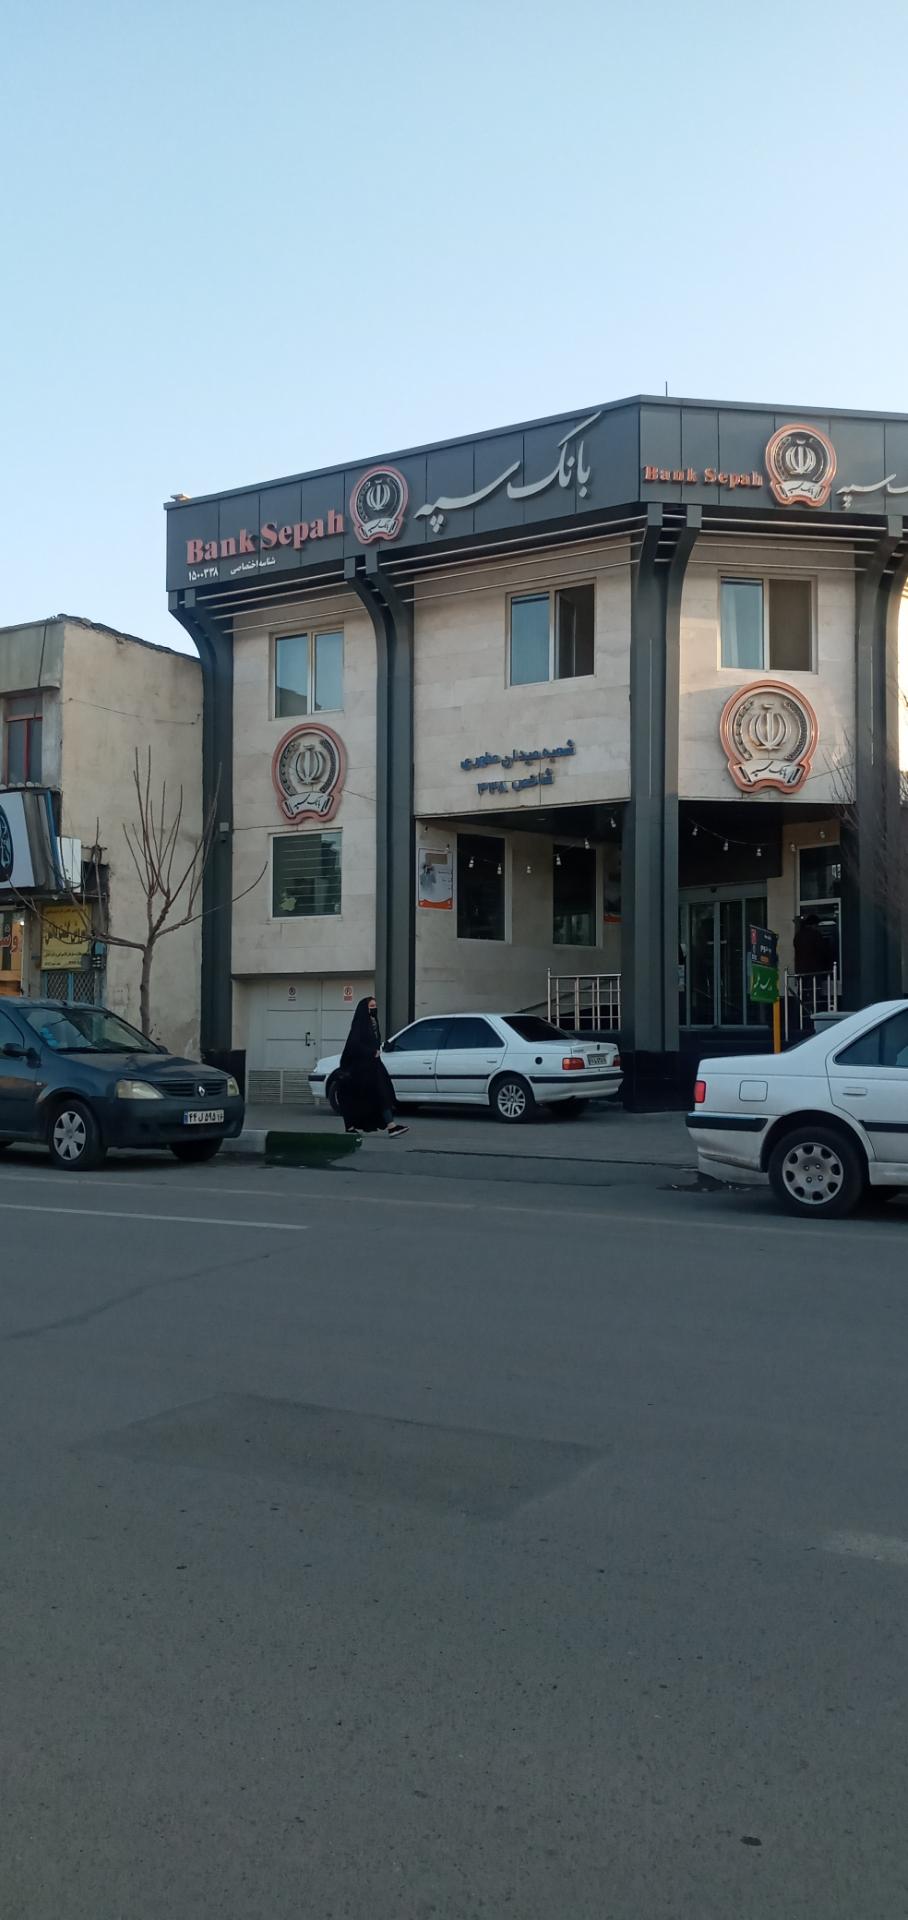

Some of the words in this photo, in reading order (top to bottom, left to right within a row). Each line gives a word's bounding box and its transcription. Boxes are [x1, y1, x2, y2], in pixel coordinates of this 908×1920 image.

[507, 410, 602, 499] بانک
[643, 465, 696, 483] Bank
[704, 467, 763, 489] Sepah
[413, 460, 521, 534] سپه
[836, 473, 897, 509] سپه
[186, 529, 256, 565] Bank
[260, 509, 344, 550] Sepah
[230, 559, 258, 575] اختصاصی
[258, 556, 276, 567] شناسه
[501, 749, 542, 769] میدان
[543, 739, 576, 763] شعبه
